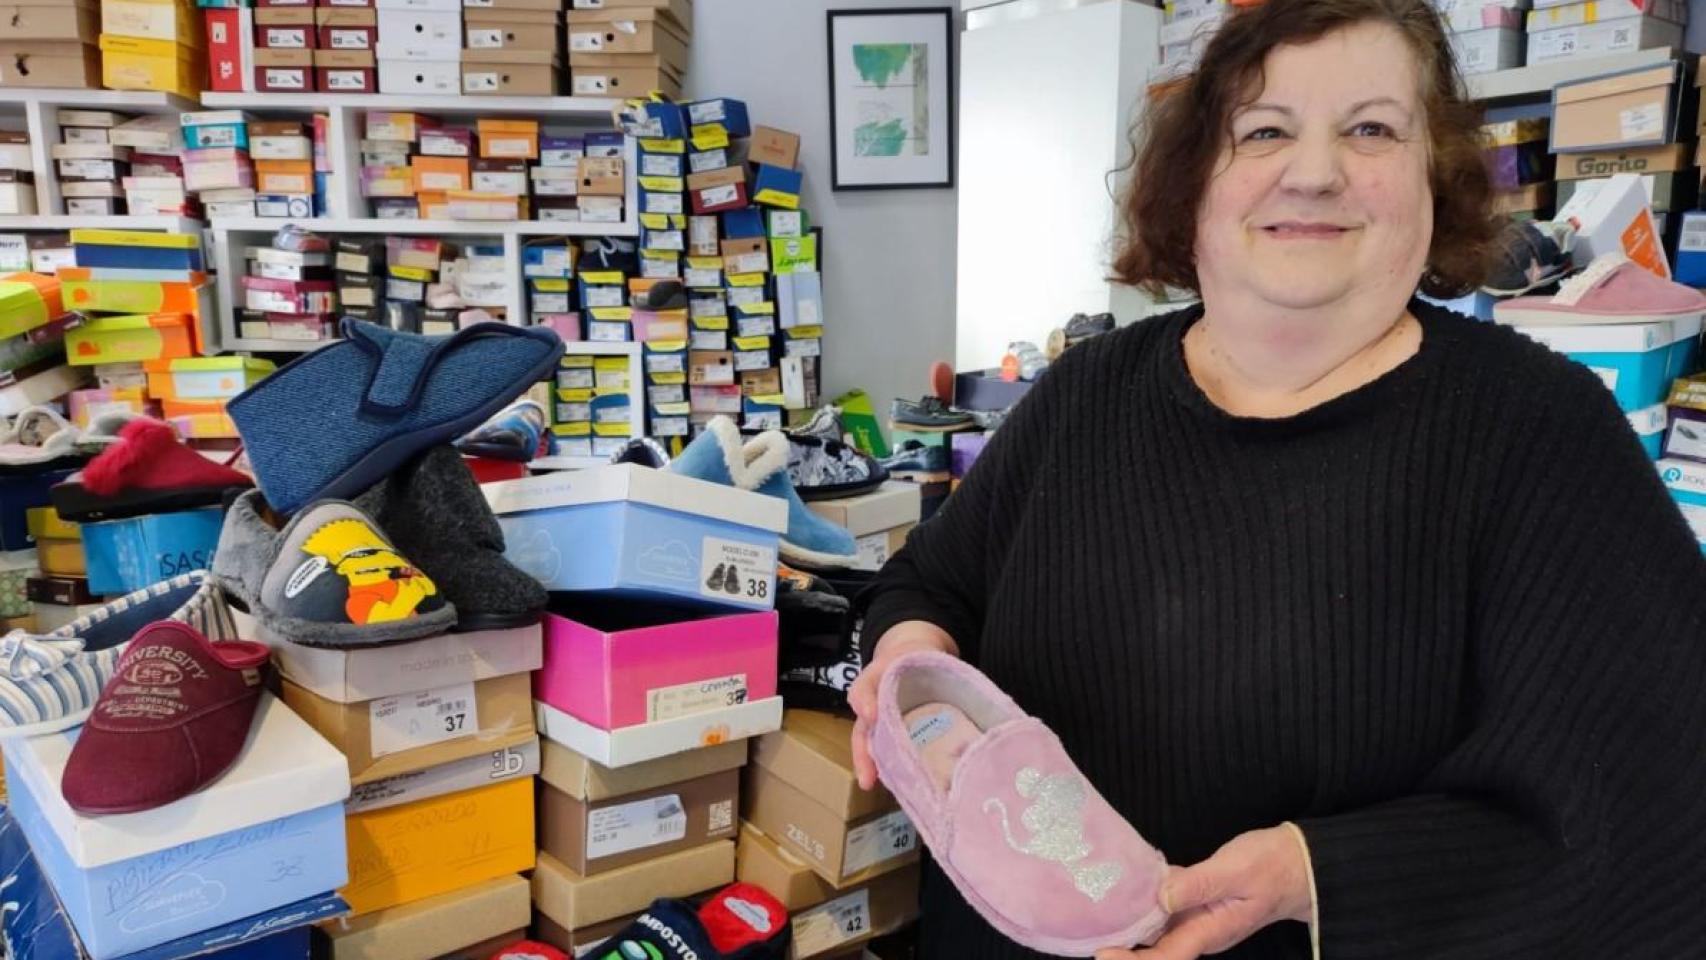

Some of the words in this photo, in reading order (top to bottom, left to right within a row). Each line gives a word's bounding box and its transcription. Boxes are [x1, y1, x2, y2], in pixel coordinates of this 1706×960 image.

[746, 578, 768, 599] 38
[444, 713, 466, 732] 37
[893, 833, 910, 848] 40
[846, 916, 863, 932] 42
